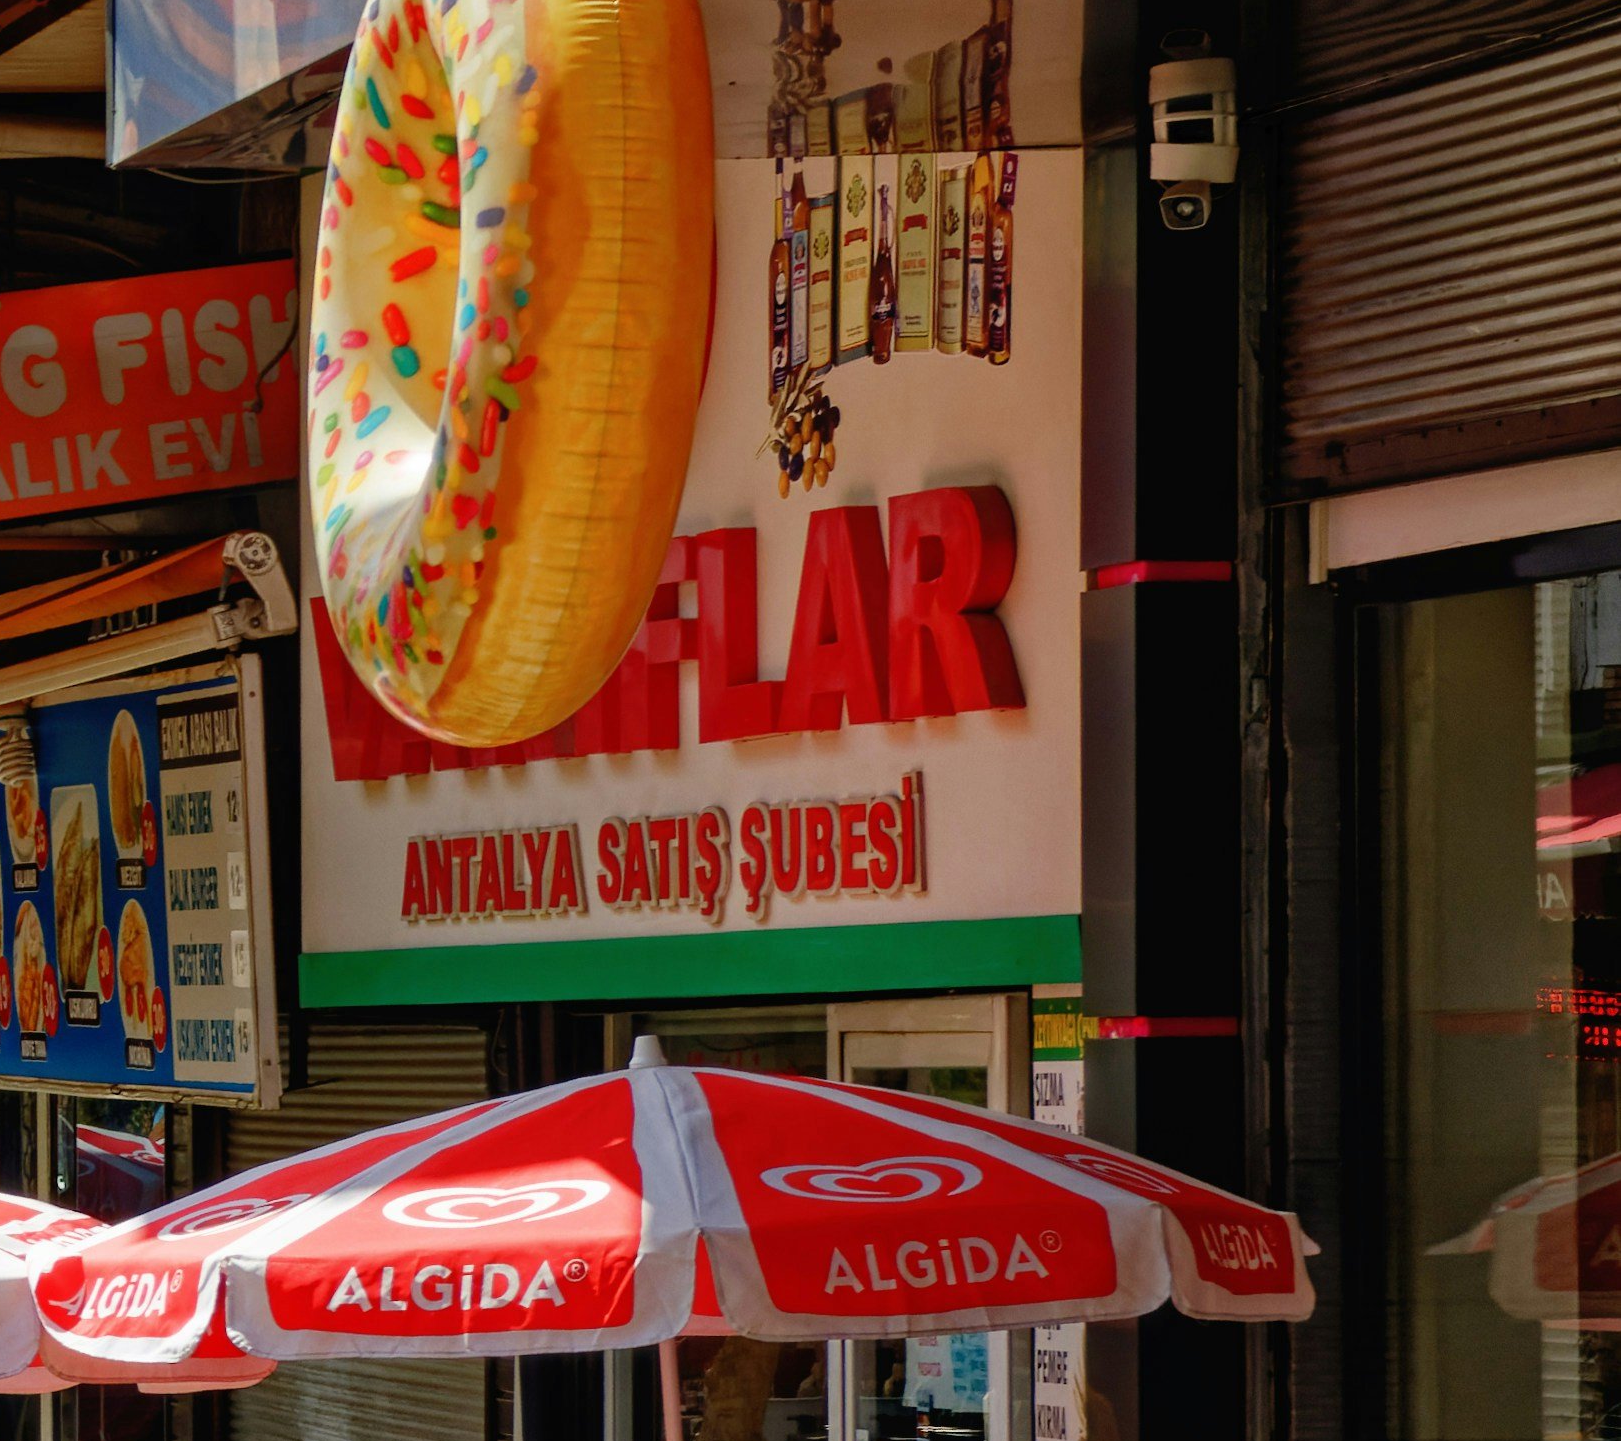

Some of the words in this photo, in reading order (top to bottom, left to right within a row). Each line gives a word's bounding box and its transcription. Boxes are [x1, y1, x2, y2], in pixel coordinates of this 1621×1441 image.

[94, 290, 299, 407] FISH
[147, 402, 264, 481] EVİ
[401, 823, 589, 923] ANTALYA
[595, 805, 731, 928] SATIŞ
[739, 768, 927, 924] ŞUBESİ
[824, 1235, 1053, 1297] ALGiDA
[1199, 1222, 1278, 1270] ALGiDA
[327, 1261, 568, 1316] ALGiDA
[1037, 1349, 1069, 1385] PEMBE
[1037, 1404, 1068, 1441] KIRMA
